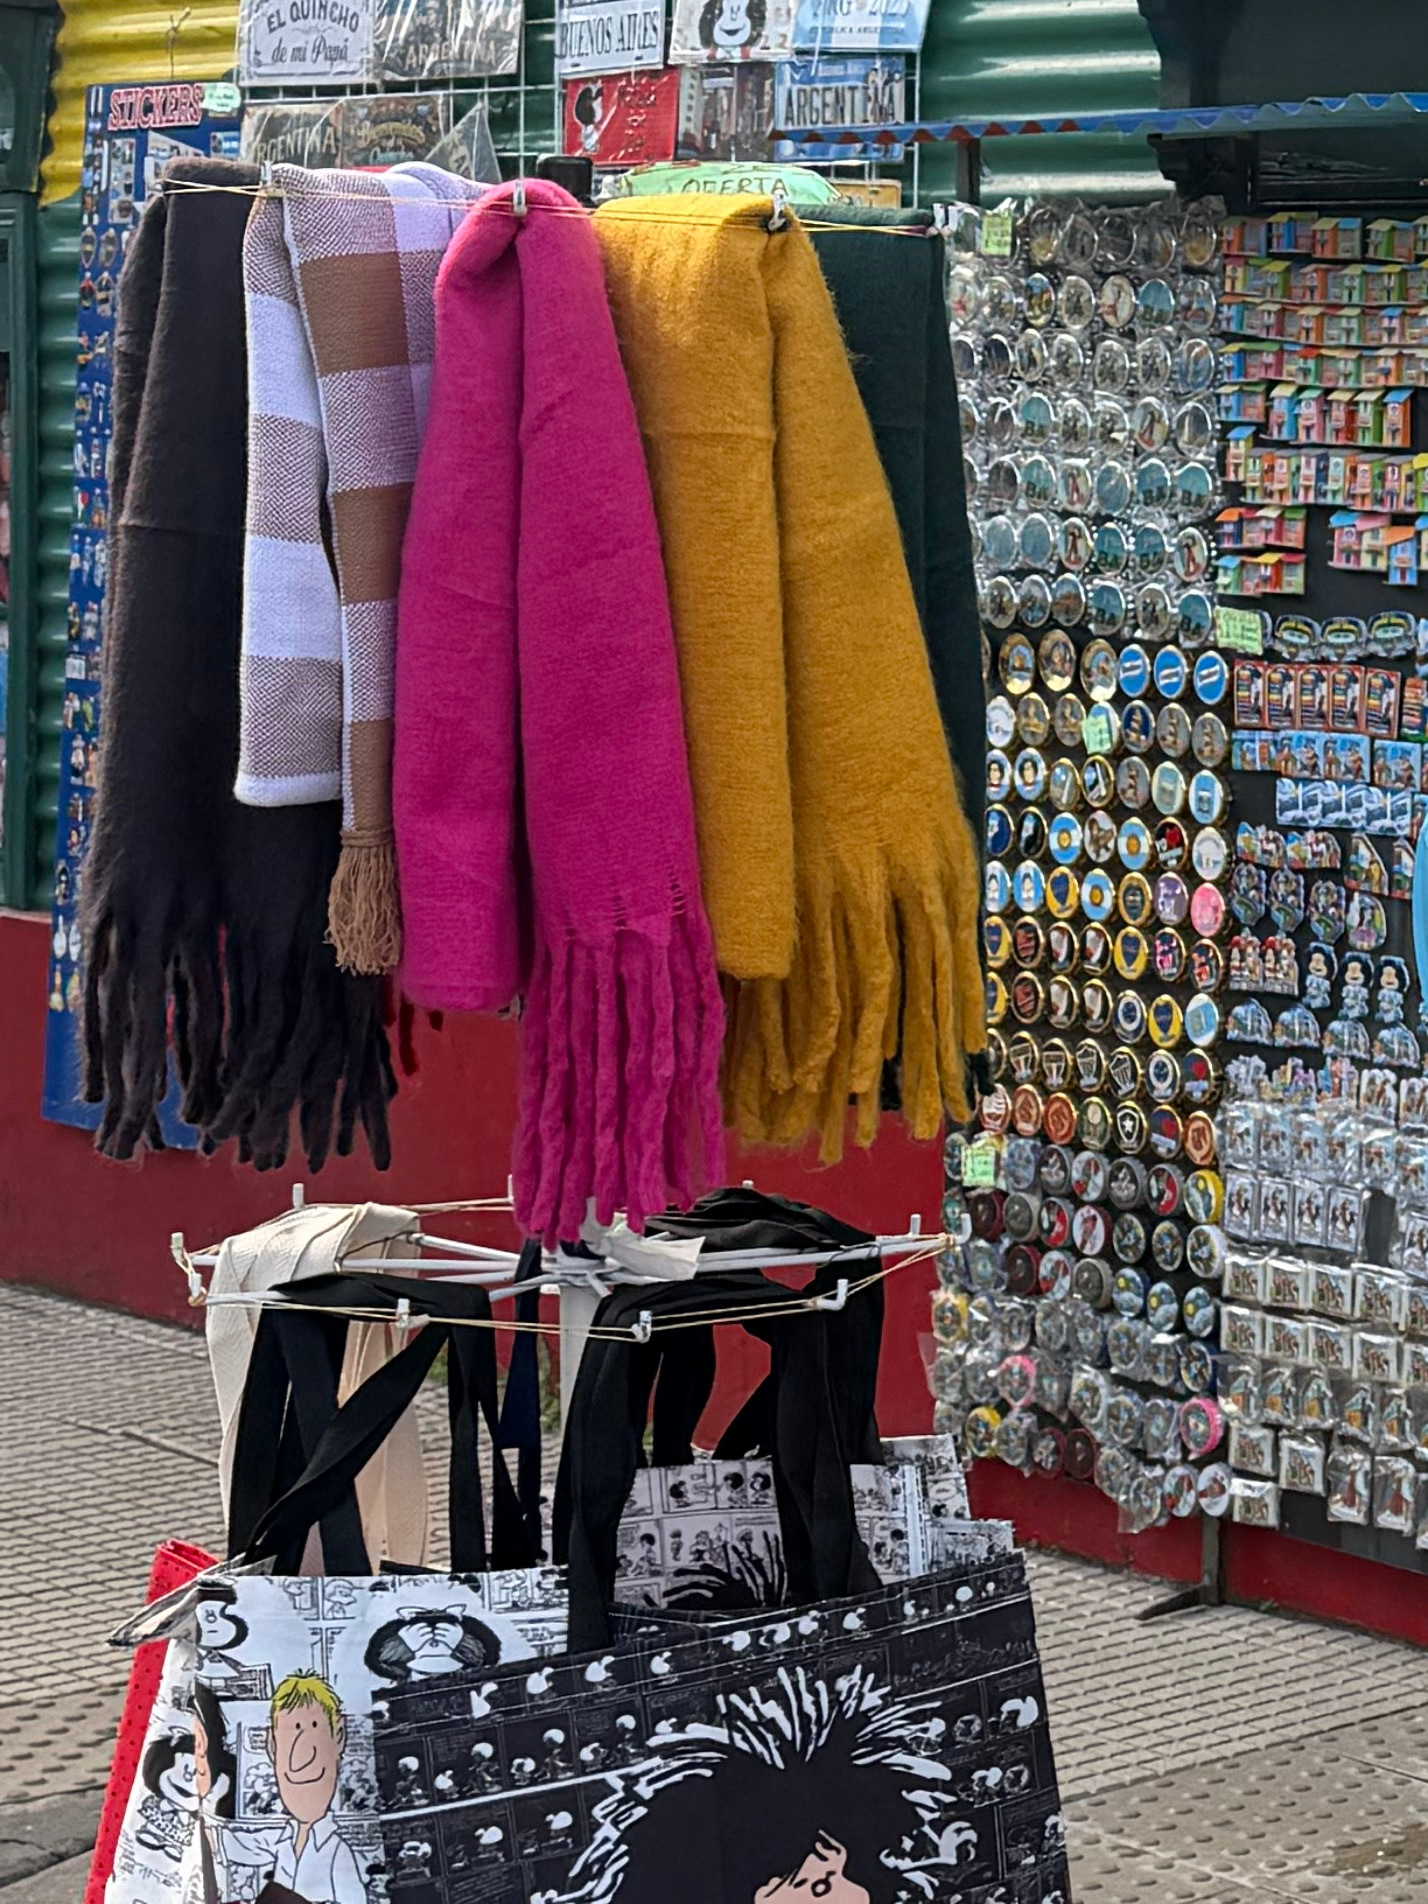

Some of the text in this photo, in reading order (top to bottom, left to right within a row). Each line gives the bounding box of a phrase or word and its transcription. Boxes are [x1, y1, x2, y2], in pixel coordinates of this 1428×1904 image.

[267, 13, 286, 34] EL
[558, 16, 613, 60] BUENOS
[271, 39, 287, 63] de
[290, 40, 308, 63] mi
[107, 85, 204, 131] STICKERS
